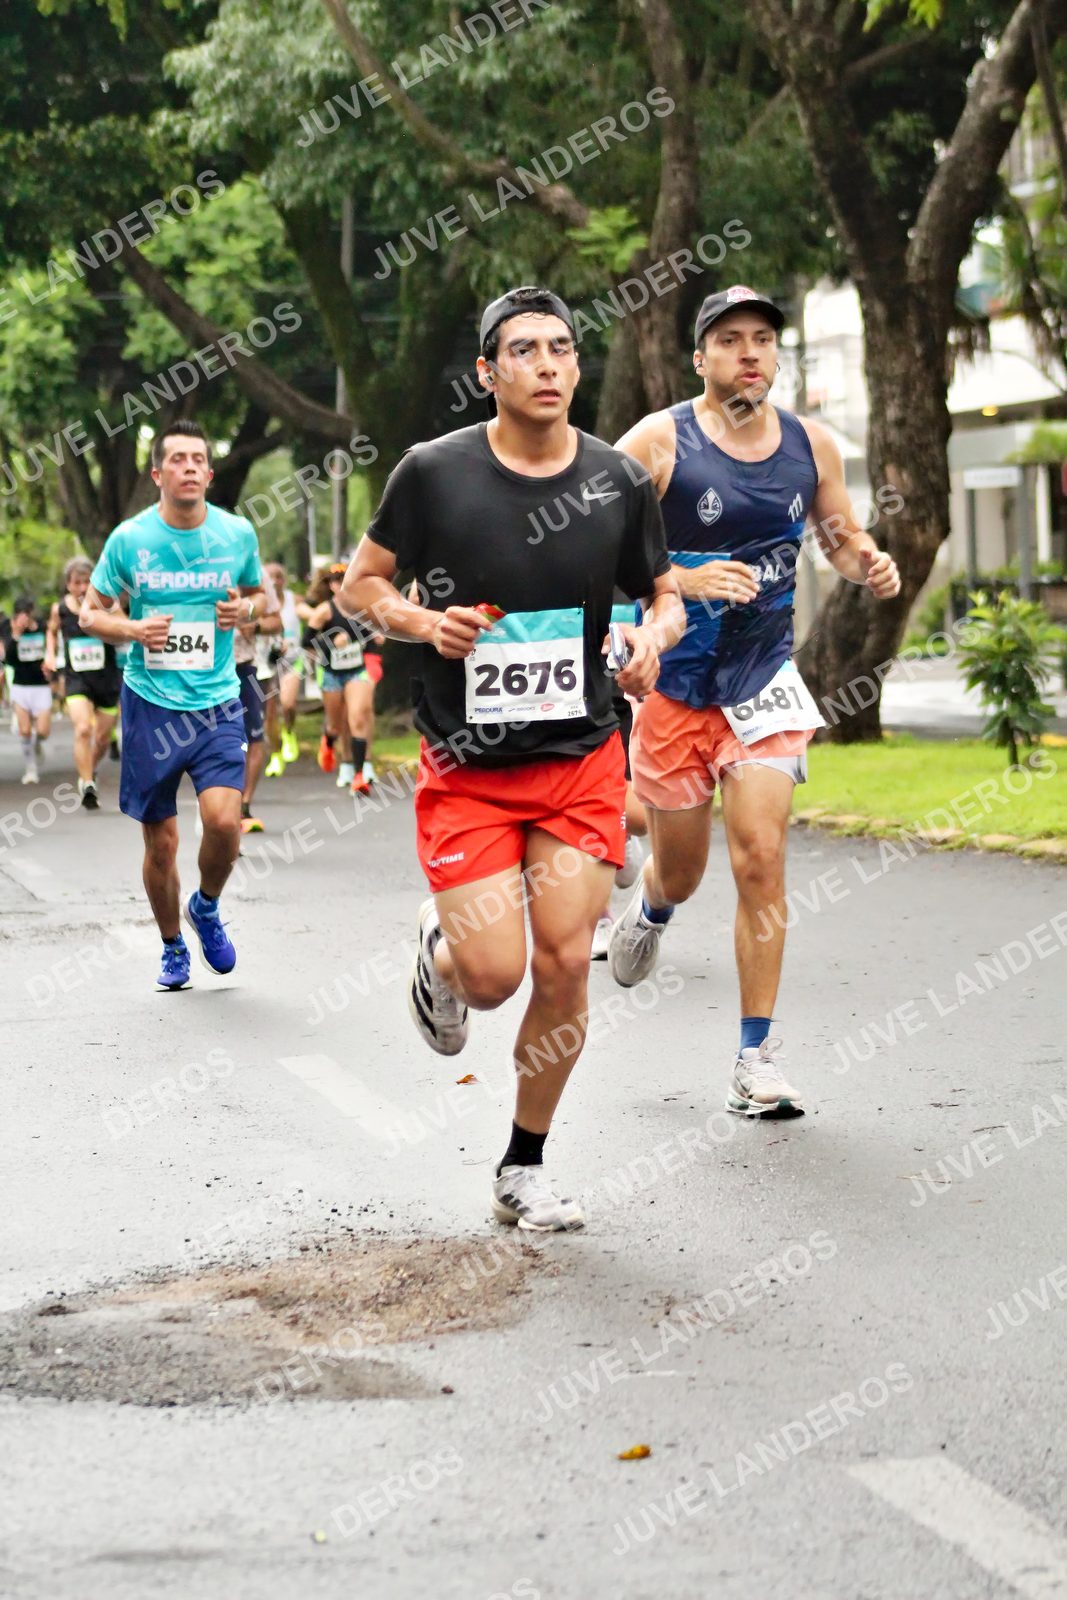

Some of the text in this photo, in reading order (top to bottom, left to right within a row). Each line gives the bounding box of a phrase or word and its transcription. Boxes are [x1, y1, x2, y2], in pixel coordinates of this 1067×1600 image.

[134, 571, 232, 589] PERDURA
[148, 634, 209, 654] 584
[474, 659, 577, 696] 2676
[732, 686, 804, 721] 6481
